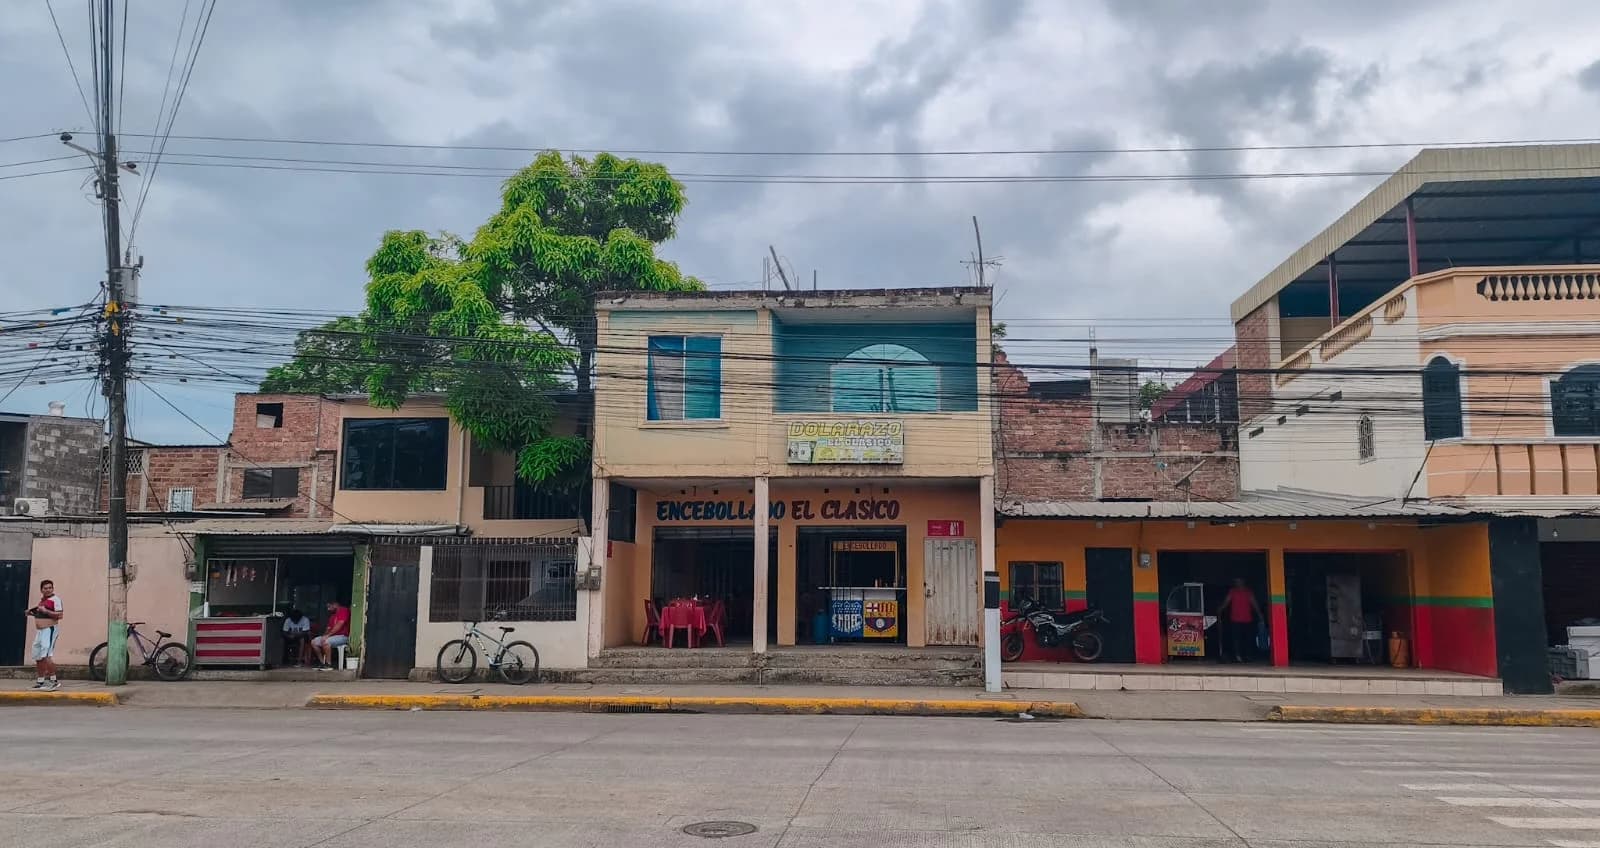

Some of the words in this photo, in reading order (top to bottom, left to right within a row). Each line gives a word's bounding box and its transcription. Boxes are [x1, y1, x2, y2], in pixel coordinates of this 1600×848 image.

[790, 421, 902, 437] DOLARAZO
[828, 438, 840, 446] EL
[846, 438, 892, 446] CLASICO
[791, 500, 815, 520] EL
[820, 500, 900, 520] CLASICO
